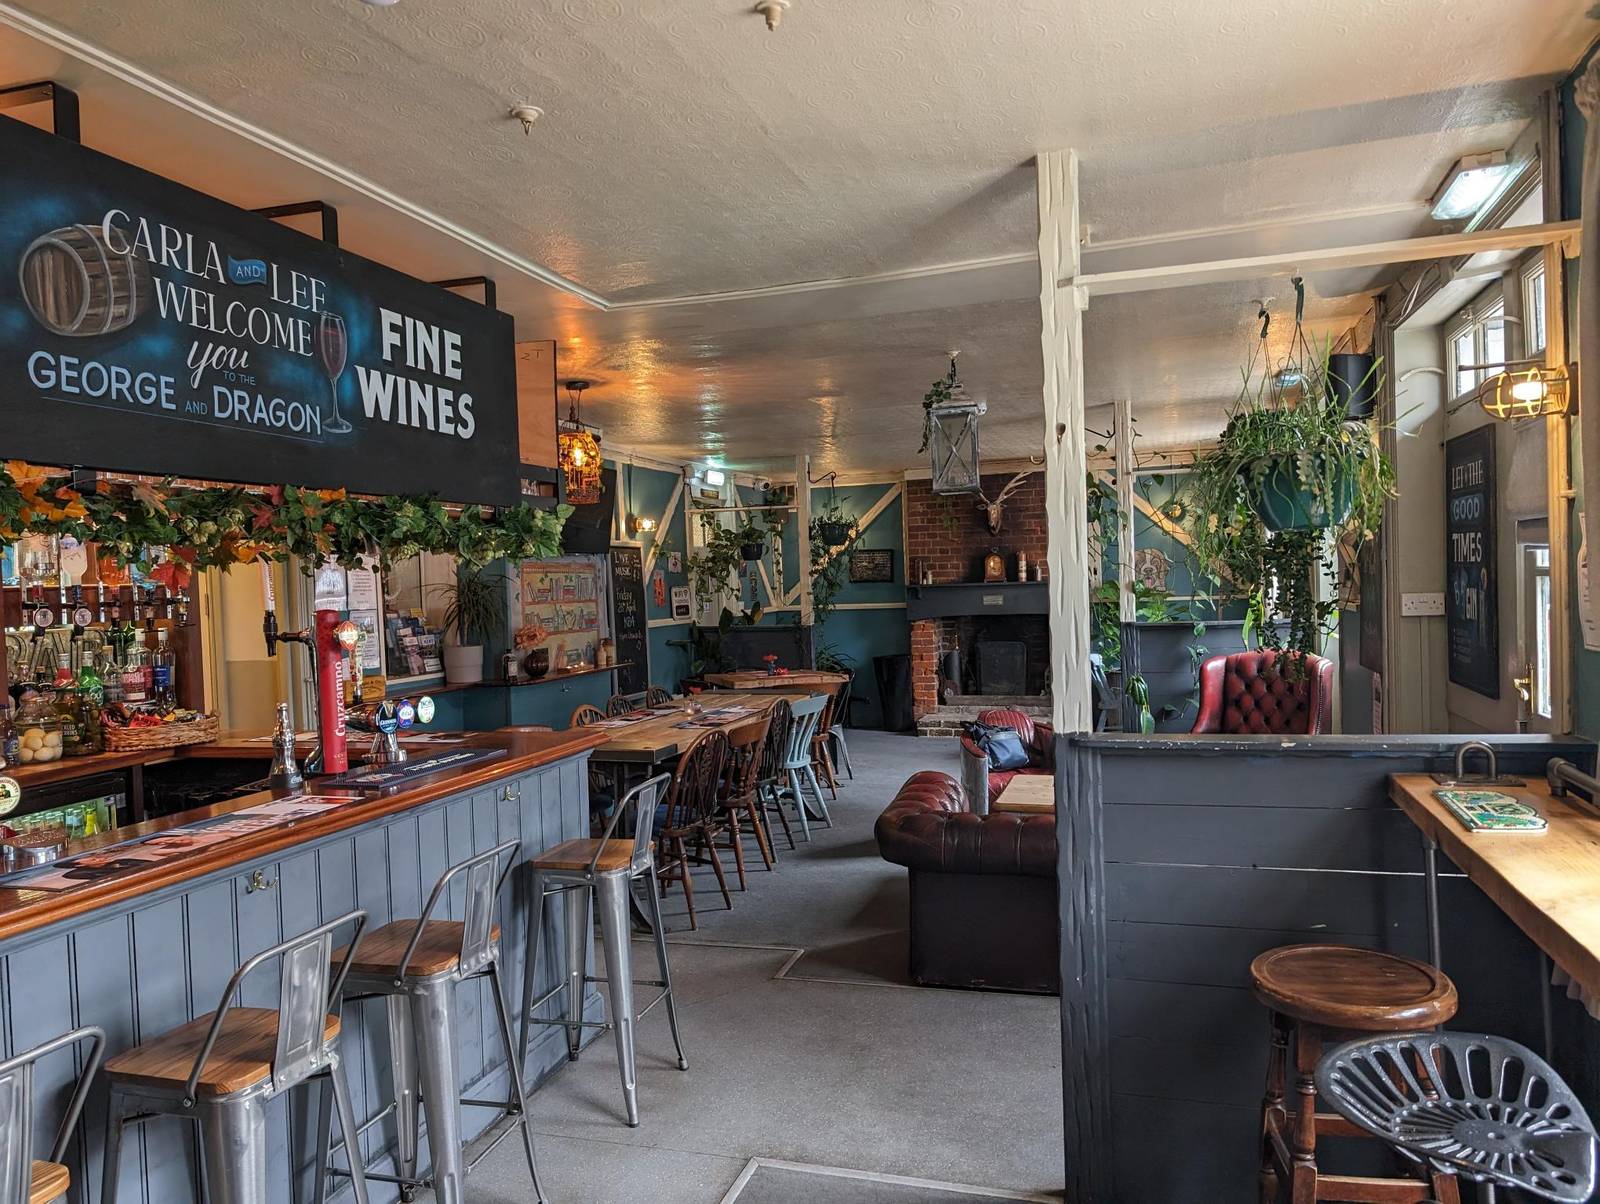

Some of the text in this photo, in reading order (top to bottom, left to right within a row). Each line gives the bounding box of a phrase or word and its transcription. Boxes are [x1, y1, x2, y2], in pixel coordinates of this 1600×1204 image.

[102, 209, 227, 285] CARLA
[236, 265, 261, 278] AND
[152, 276, 314, 357] WELCOME
[187, 340, 249, 389] you
[379, 308, 463, 381] FINE
[27, 350, 322, 436] GEORGE AND DRAGON
[223, 370, 256, 386] TO THE
[355, 363, 476, 440] WINES
[1452, 460, 1483, 490] LET THE
[1453, 497, 1480, 521] GOOD
[1452, 532, 1482, 563] TIMES
[1466, 587, 1478, 619] GIN
